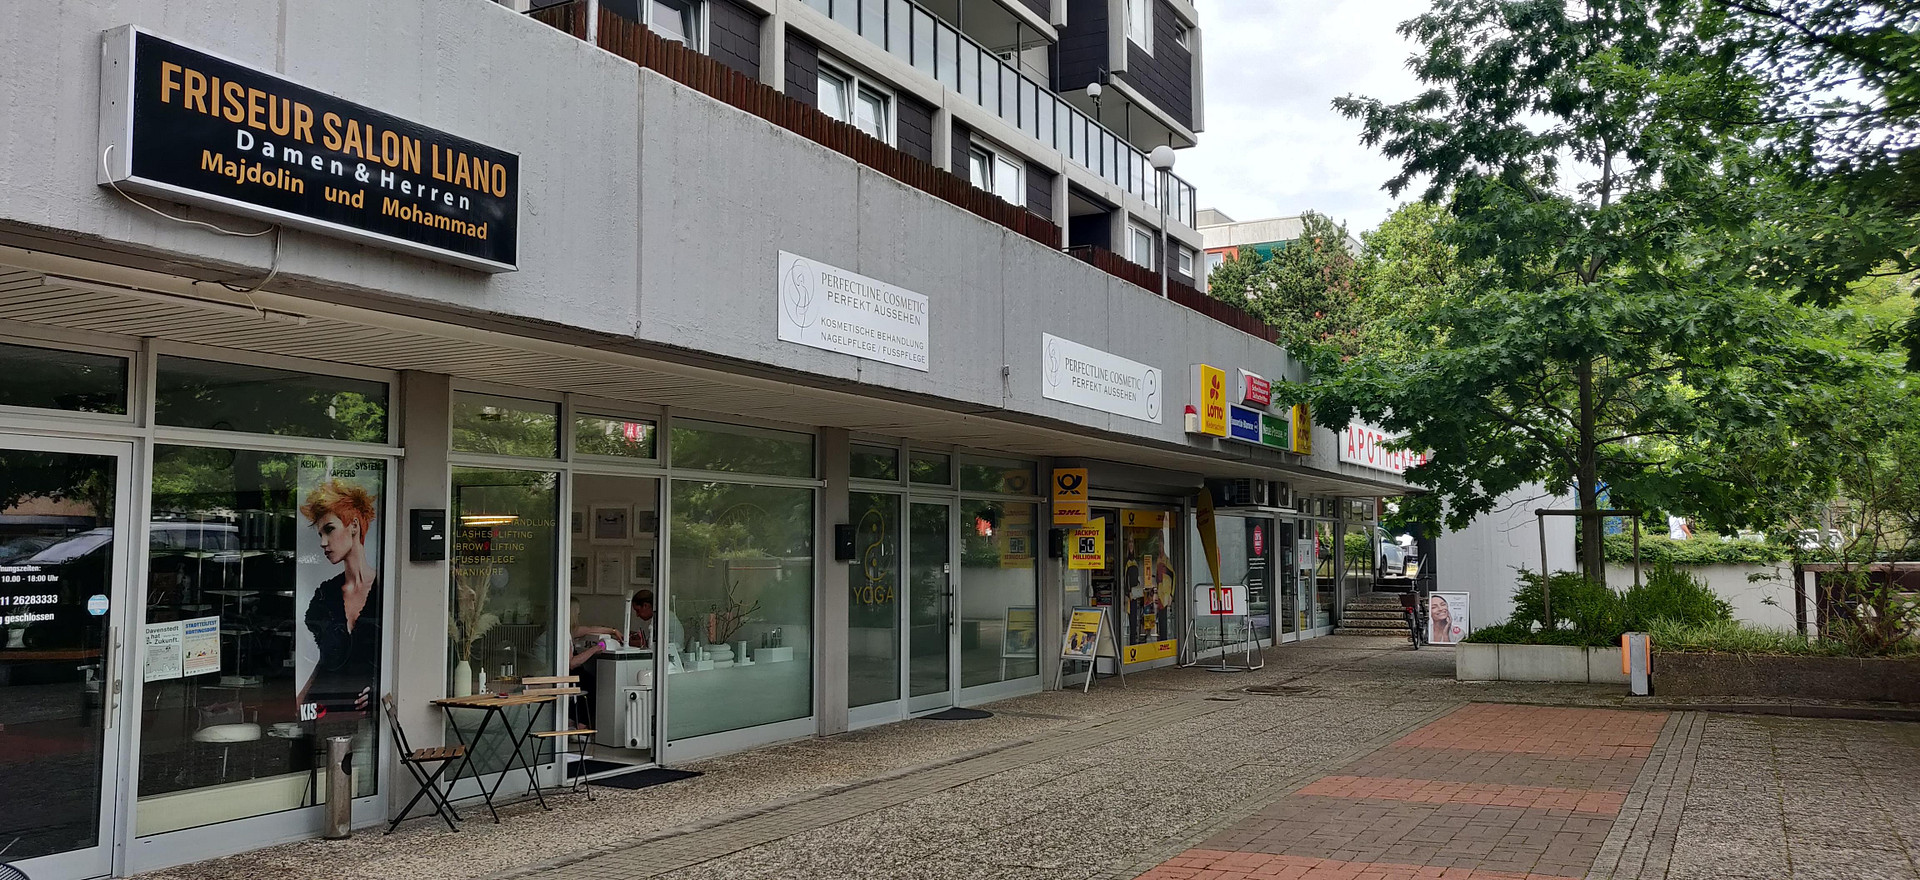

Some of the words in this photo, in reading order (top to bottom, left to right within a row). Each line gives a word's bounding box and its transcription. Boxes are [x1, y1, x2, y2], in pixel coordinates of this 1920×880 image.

[161, 60, 314, 144] FRISEUR
[322, 112, 421, 175] SALON
[432, 144, 507, 198] LIANO
[236, 129, 343, 176] Damen
[355, 163, 370, 184] &
[380, 169, 470, 210] Herren
[201, 149, 304, 194] Majdolin
[324, 186, 365, 209] und
[381, 196, 488, 240] Mohammad
[821, 272, 881, 302] PERFECTLINE
[883, 291, 926, 315] COSMETIC
[827, 290, 871, 312] PERFEKT
[874, 304, 921, 326] AUSSEHEN
[820, 317, 877, 338] KOSMETISCHE
[877, 331, 924, 350] BEHANDLUNG
[820, 332, 876, 353] NAGELPFLEGE
[882, 346, 926, 364] FUSSPFLEGE
[1064, 357, 1108, 382] PERFECTLINE
[1109, 371, 1142, 391] COSMETIC
[1072, 376, 1102, 393] PERFEKT
[1104, 386, 1137, 402] AUSSEHEN
[1207, 404, 1223, 420] LOTTO
[498, 531, 533, 539] LIFTING
[456, 543, 483, 551] BROW
[490, 543, 525, 551] LIFTING
[1080, 538, 1095, 553] 50
[455, 556, 515, 564] FUSSPFLEGE
[2, 575, 20, 583] 10.00
[47, 574, 59, 582] Uhr
[13, 594, 58, 605] 26283333
[853, 585, 895, 604] YOGA
[5, 613, 55, 625] geschlossen
[145, 625, 179, 635] Davenstedt
[300, 702, 318, 722] KIS
